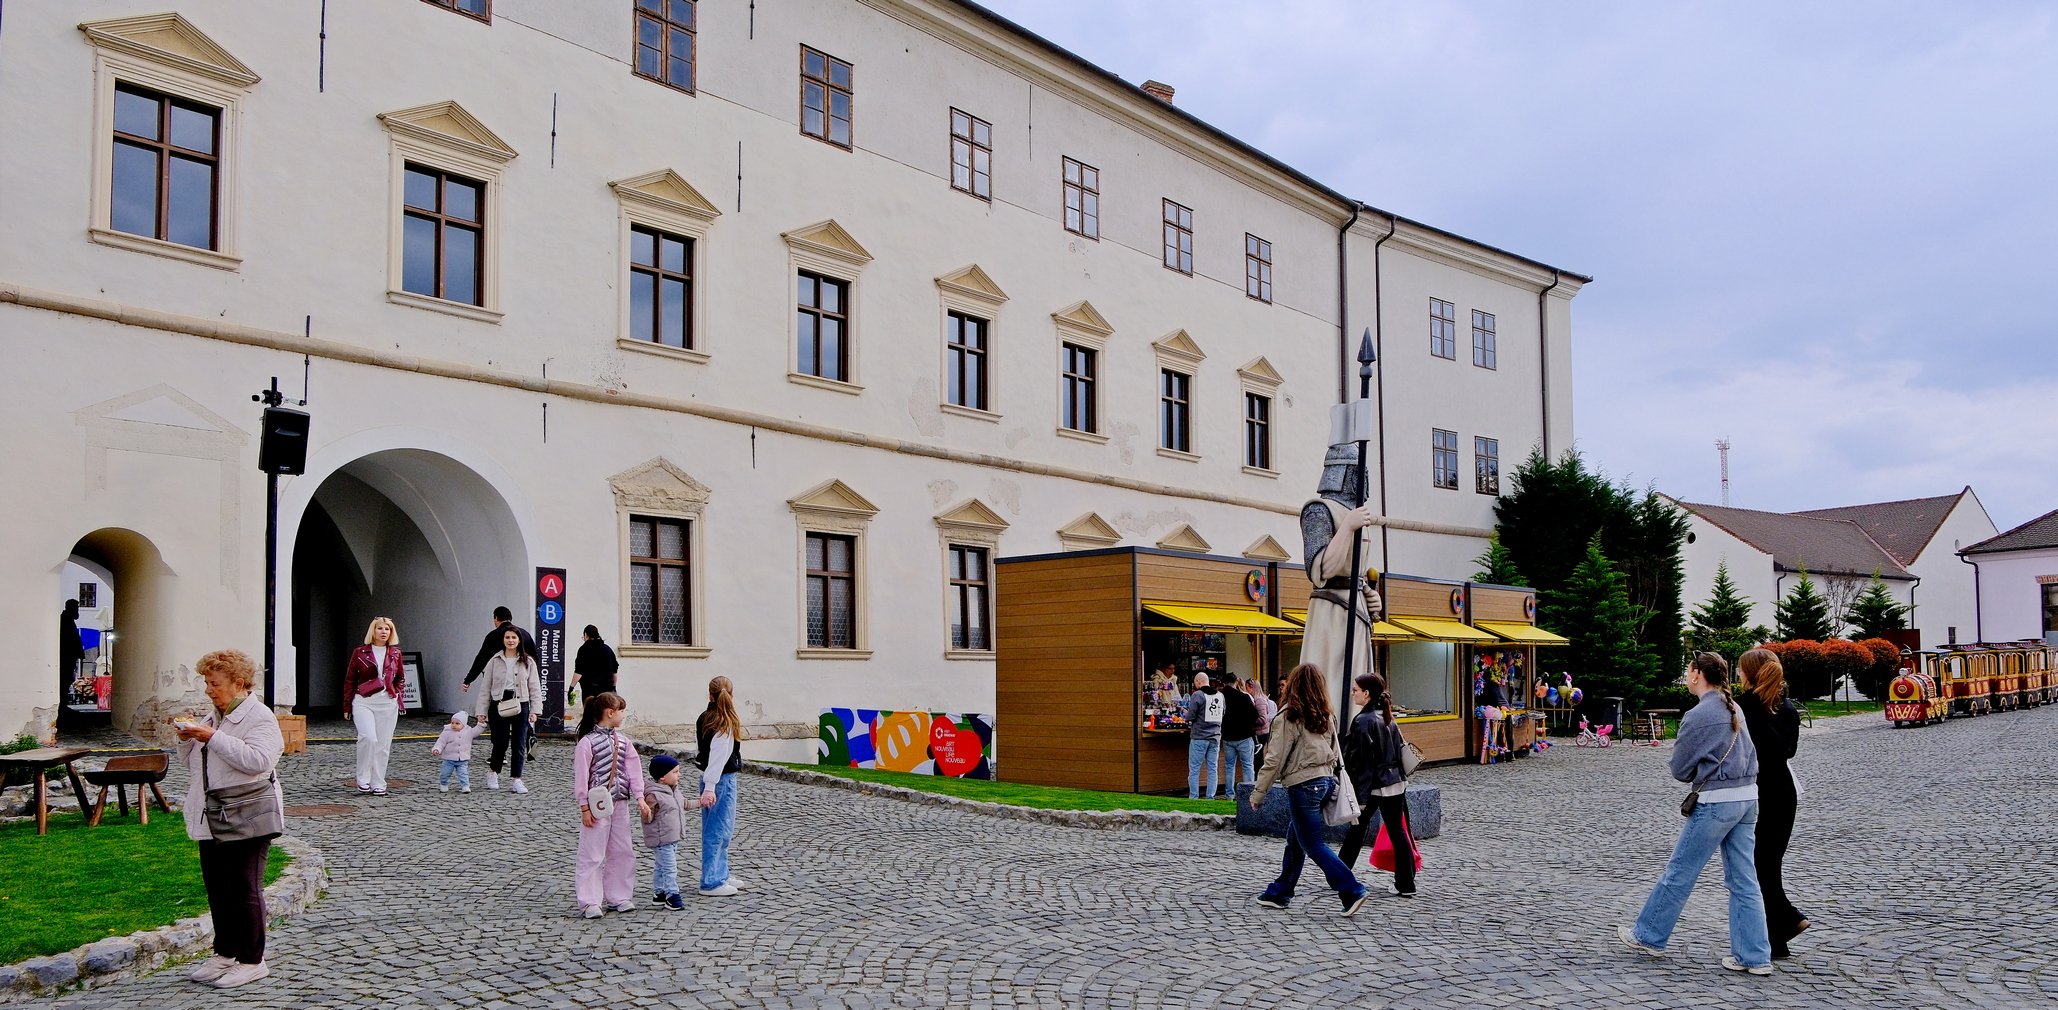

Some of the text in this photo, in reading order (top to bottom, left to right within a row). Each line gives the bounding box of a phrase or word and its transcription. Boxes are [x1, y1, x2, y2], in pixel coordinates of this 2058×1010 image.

[544, 578, 558, 594] A
[545, 604, 557, 620] B
[552, 629, 560, 662] Muzeul
[596, 800, 606, 811] C
